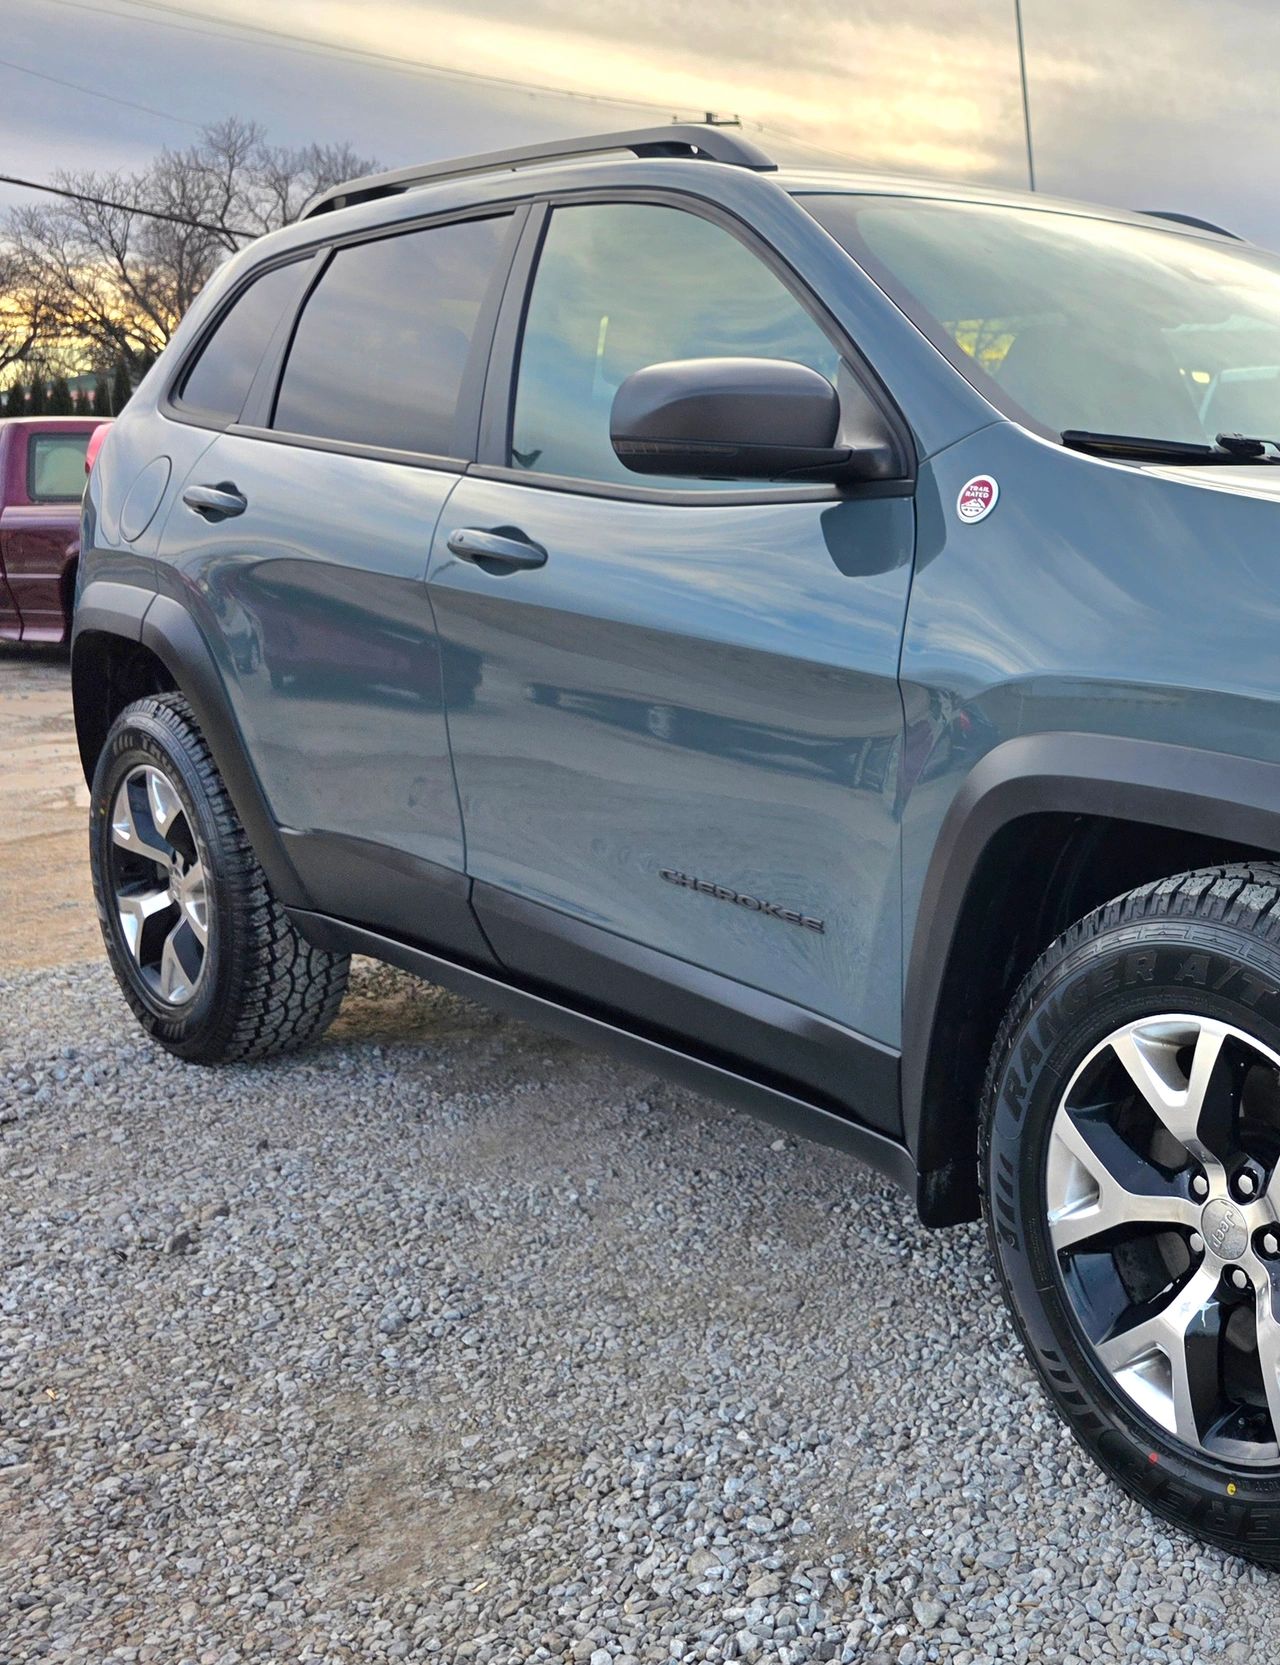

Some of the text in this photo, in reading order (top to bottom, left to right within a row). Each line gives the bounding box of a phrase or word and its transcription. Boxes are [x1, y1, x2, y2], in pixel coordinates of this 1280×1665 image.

[659, 867, 825, 934] CHEROKEE
[1002, 950, 1280, 1122] RANGER A/T
[1211, 1210, 1236, 1248] Jeep
